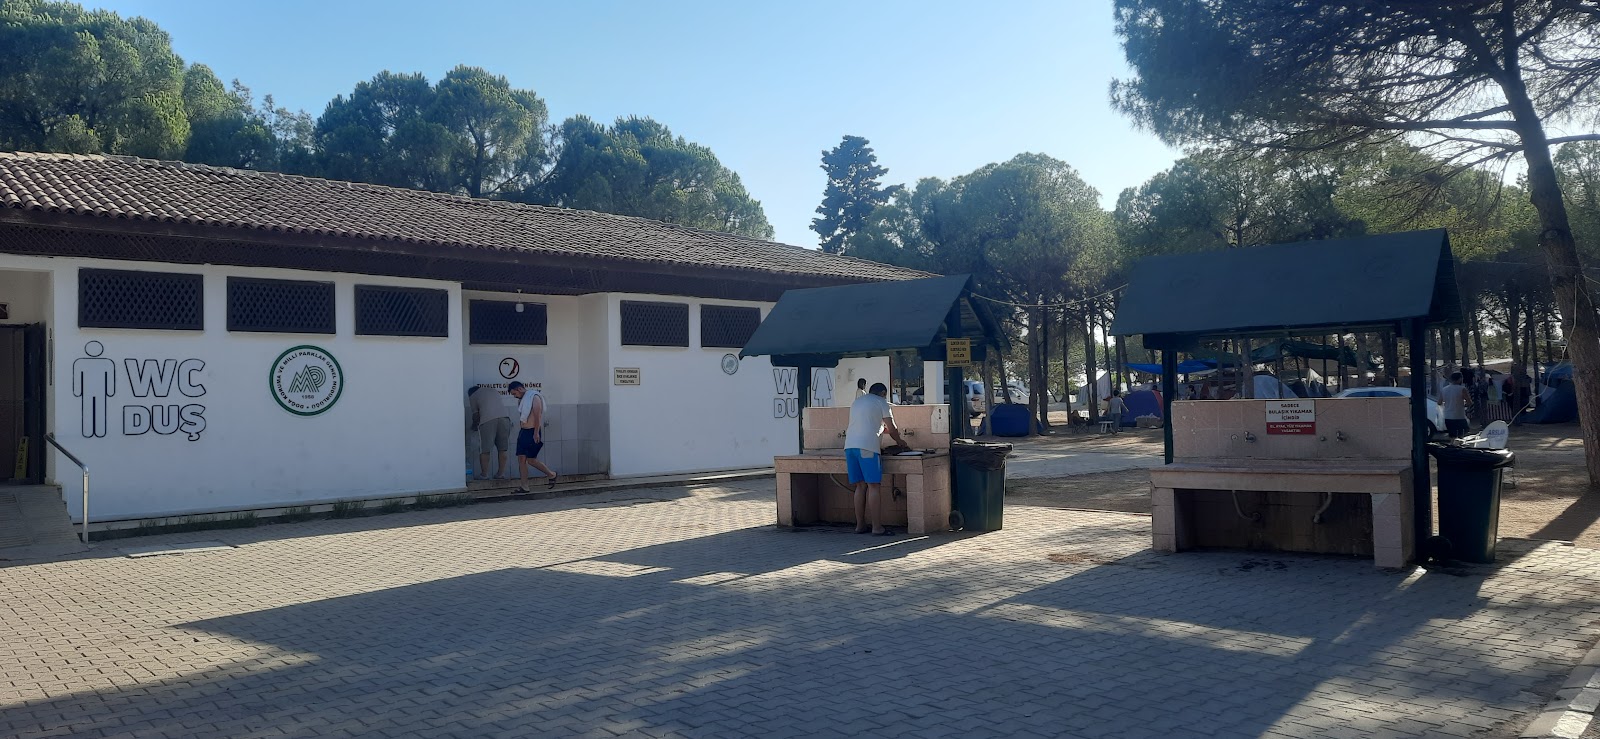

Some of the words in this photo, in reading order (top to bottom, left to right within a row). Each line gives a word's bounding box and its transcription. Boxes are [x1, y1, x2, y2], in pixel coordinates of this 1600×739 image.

[298, 351, 327, 362] PARKLAR
[123, 358, 206, 398] WC
[278, 365, 285, 373] VE
[326, 361, 337, 379] GENEL
[276, 375, 287, 400] KORUMA
[122, 403, 207, 442] DUŞ
